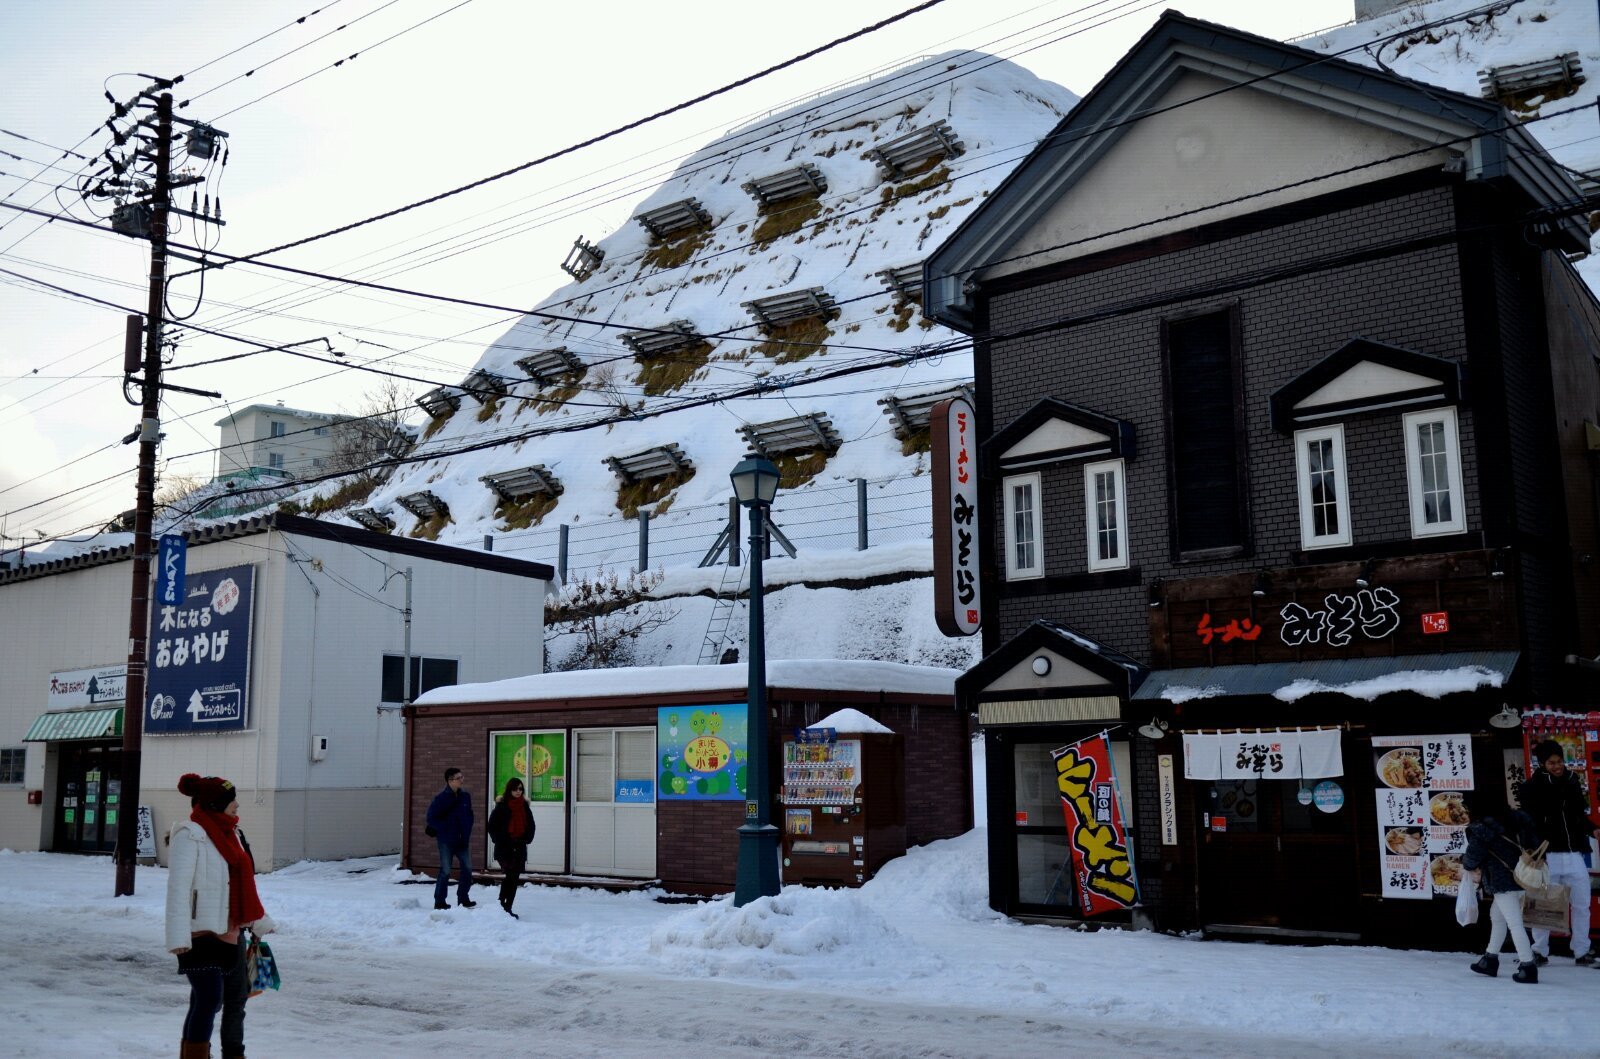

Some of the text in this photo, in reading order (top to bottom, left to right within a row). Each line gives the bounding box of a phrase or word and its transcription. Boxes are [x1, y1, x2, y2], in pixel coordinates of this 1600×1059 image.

[957, 412, 969, 484] ラーメン
[953, 492, 976, 606] みそら
[160, 605, 212, 632] 木になる
[1197, 613, 1262, 645] ラーメン
[1280, 586, 1400, 647] みそら
[155, 629, 230, 668] おみやげ
[1240, 742, 1269, 754] ラーメン
[1236, 753, 1284, 773] みそら
[1431, 779, 1471, 789] RAMEN
[1390, 877, 1419, 890] みそら
